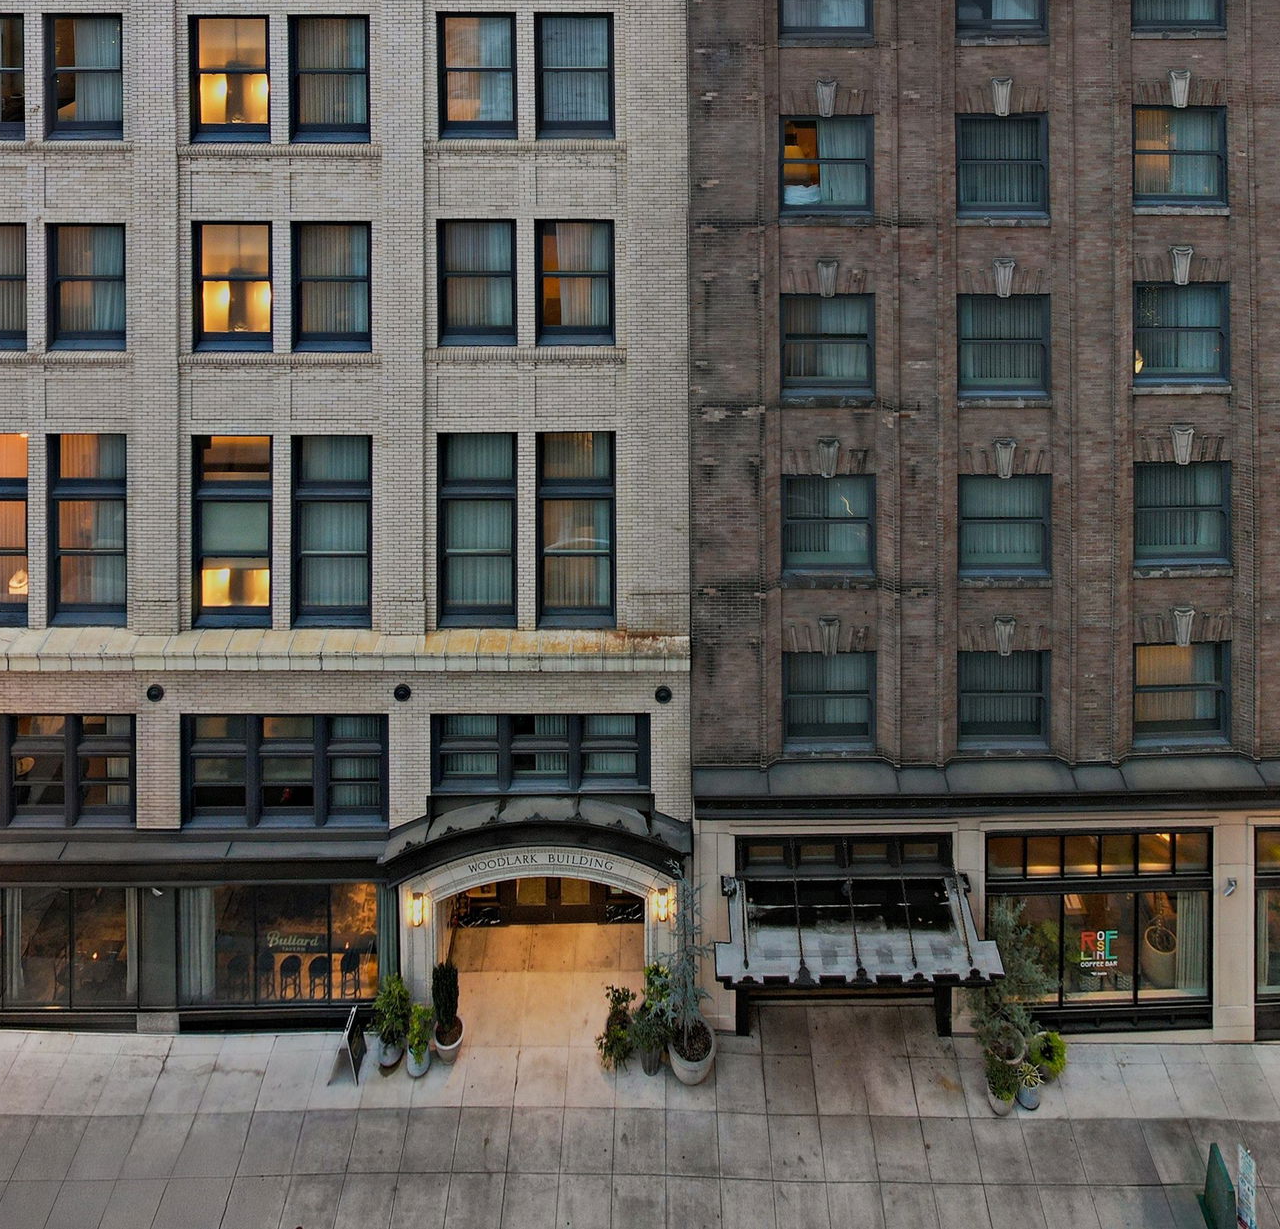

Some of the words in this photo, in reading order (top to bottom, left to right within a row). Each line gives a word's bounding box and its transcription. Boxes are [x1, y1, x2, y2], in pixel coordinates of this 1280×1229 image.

[468, 854, 538, 873] WOODLARK
[548, 853, 614, 871] BUILDING
[267, 930, 320, 948] Bullard
